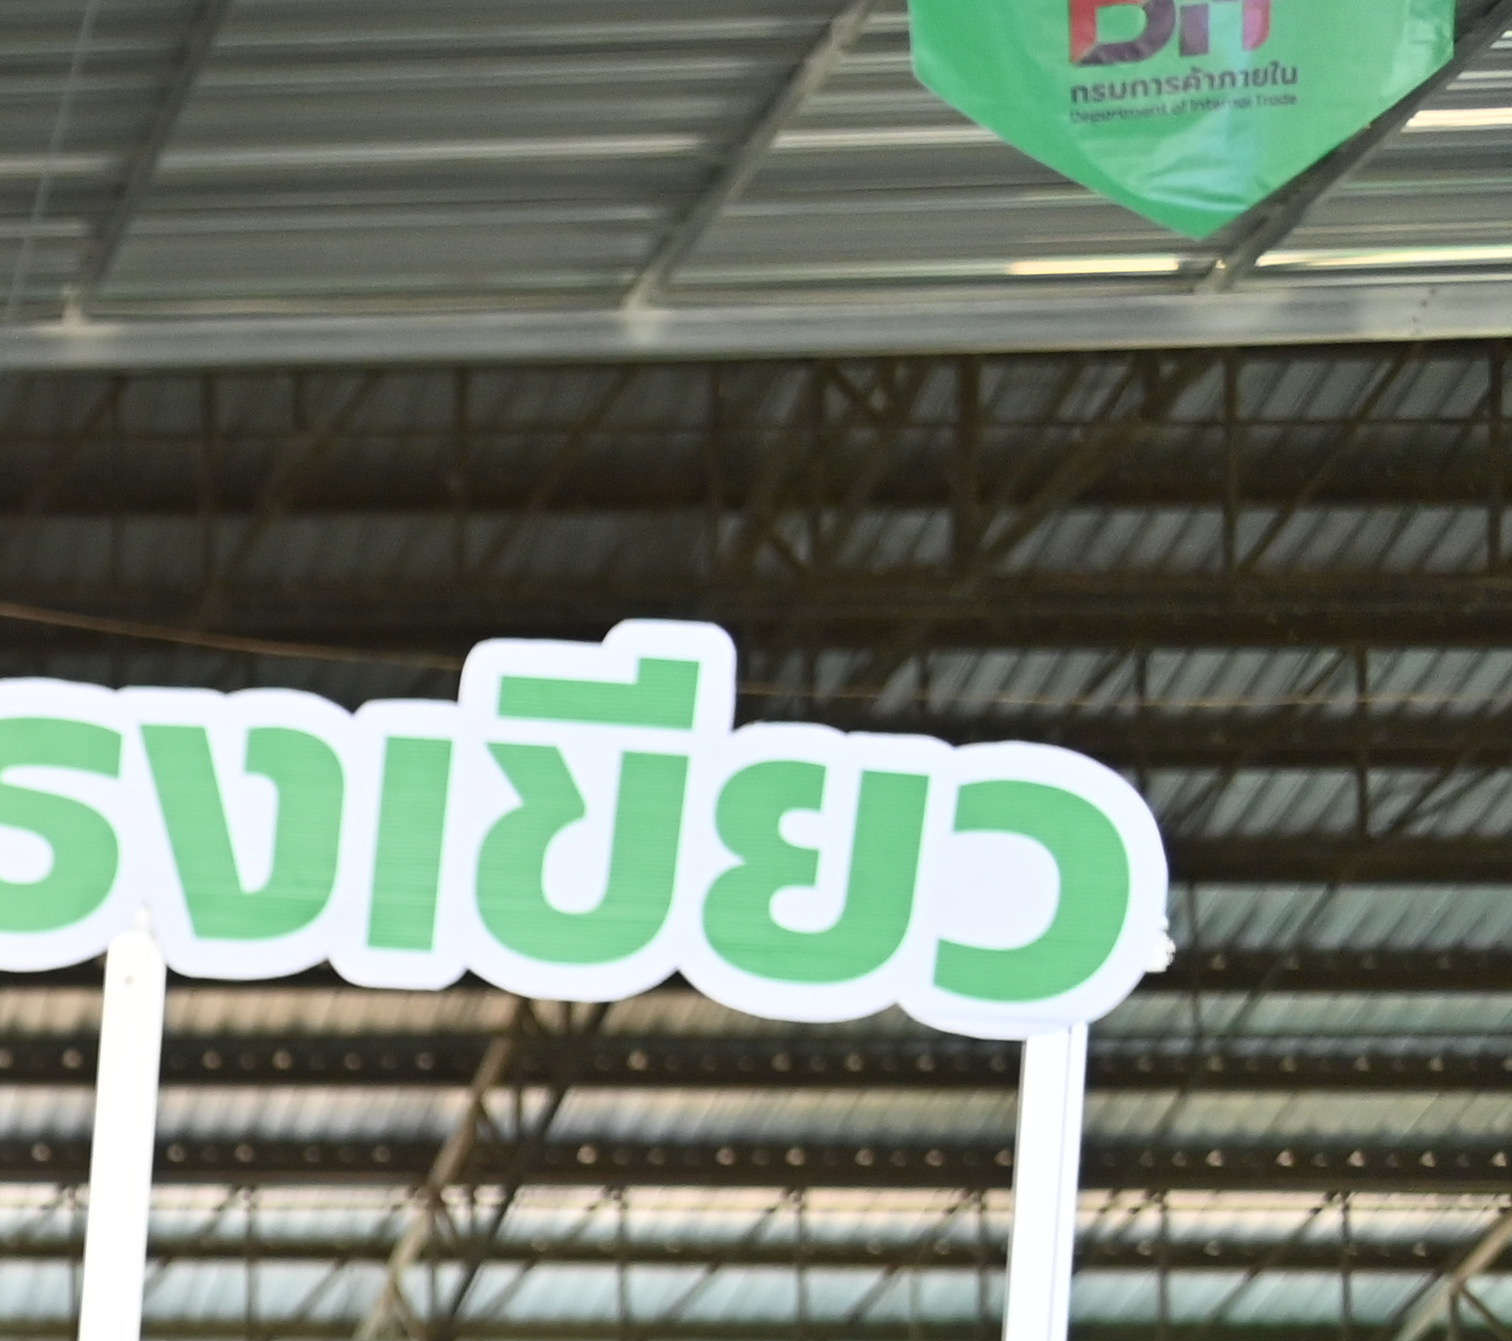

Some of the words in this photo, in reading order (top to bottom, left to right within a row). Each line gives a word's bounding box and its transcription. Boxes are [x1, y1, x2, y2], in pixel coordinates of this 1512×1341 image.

[1070, 60, 1300, 106] กรมการค้าภายใน
